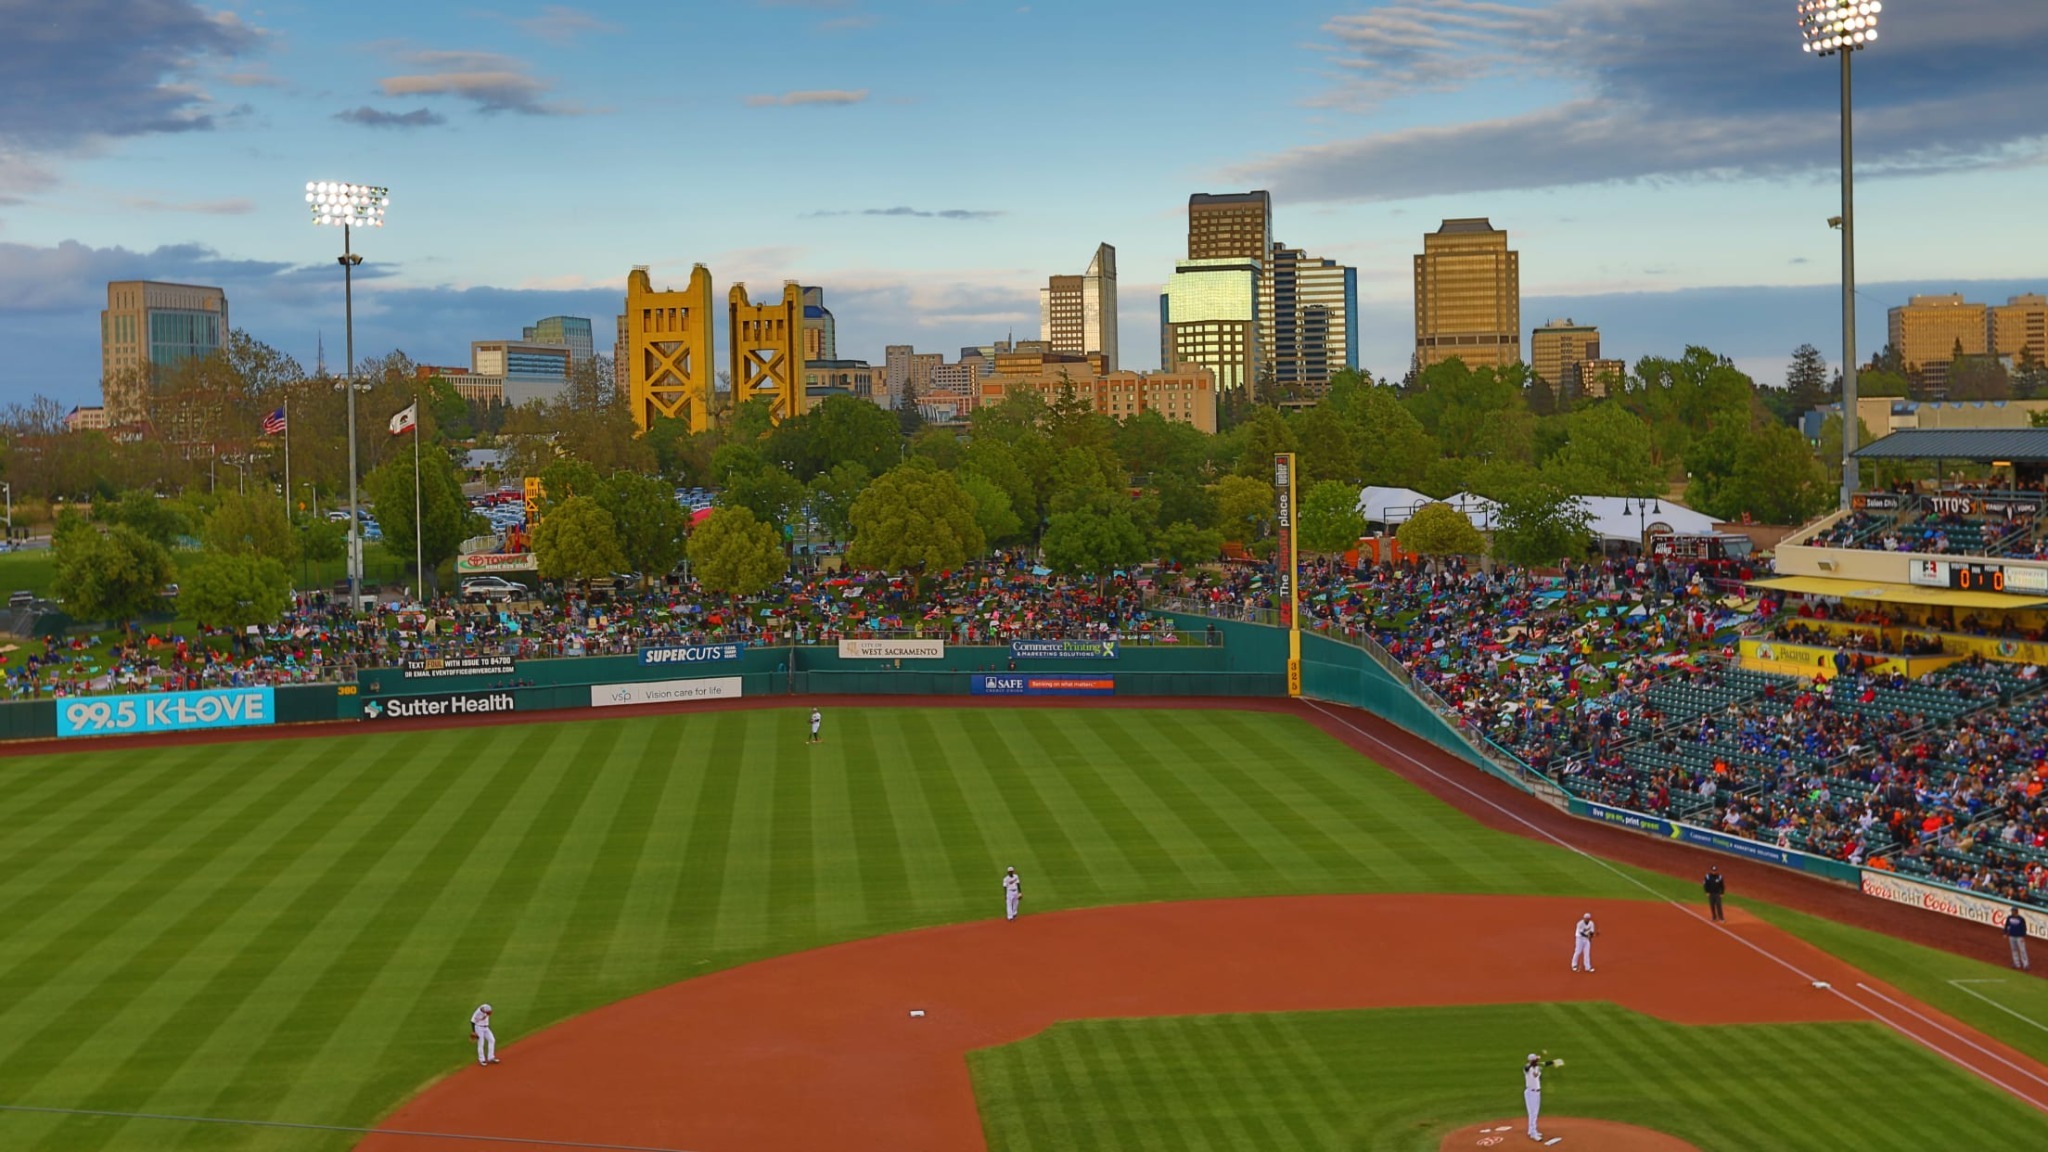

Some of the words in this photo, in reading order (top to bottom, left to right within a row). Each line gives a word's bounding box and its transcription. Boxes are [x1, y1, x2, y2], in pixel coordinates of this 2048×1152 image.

[1278, 491, 1290, 527] place.
[1931, 497, 1971, 515] TITO'S
[485, 555, 528, 565] TOYOTA
[1279, 575, 1289, 597] The
[1960, 569, 1970, 588] 0
[1994, 572, 2003, 591] 0
[645, 646, 721, 663] SUPERCUTS
[861, 648, 882, 656] WEST
[885, 648, 938, 656] SACRAMENTO
[1013, 641, 1063, 651] Commerce
[1063, 641, 1101, 654] Printing
[408, 660, 425, 670] TEXT
[445, 658, 461, 668] WITH
[462, 657, 480, 667] ISSUE
[481, 657, 489, 666] TO
[413, 669, 431, 678] EMAIL
[337, 685, 357, 695] 380
[997, 679, 1023, 689] SAFE
[611, 690, 632, 703] vsp
[646, 689, 672, 699] Vision
[674, 690, 693, 698] care
[695, 688, 706, 696] for
[709, 686, 722, 695] life
[387, 697, 448, 718] Sutter
[451, 693, 514, 714] Health
[66, 701, 137, 731] 99.5
[1593, 808, 1603, 817] live
[1625, 816, 1640, 827] print
[1861, 878, 1892, 900] Coors
[1892, 889, 1921, 904] LIGHT
[1923, 892, 1958, 915] Coors
[1959, 908, 1990, 922] LIGHT
[2029, 923, 2048, 938] LIG
